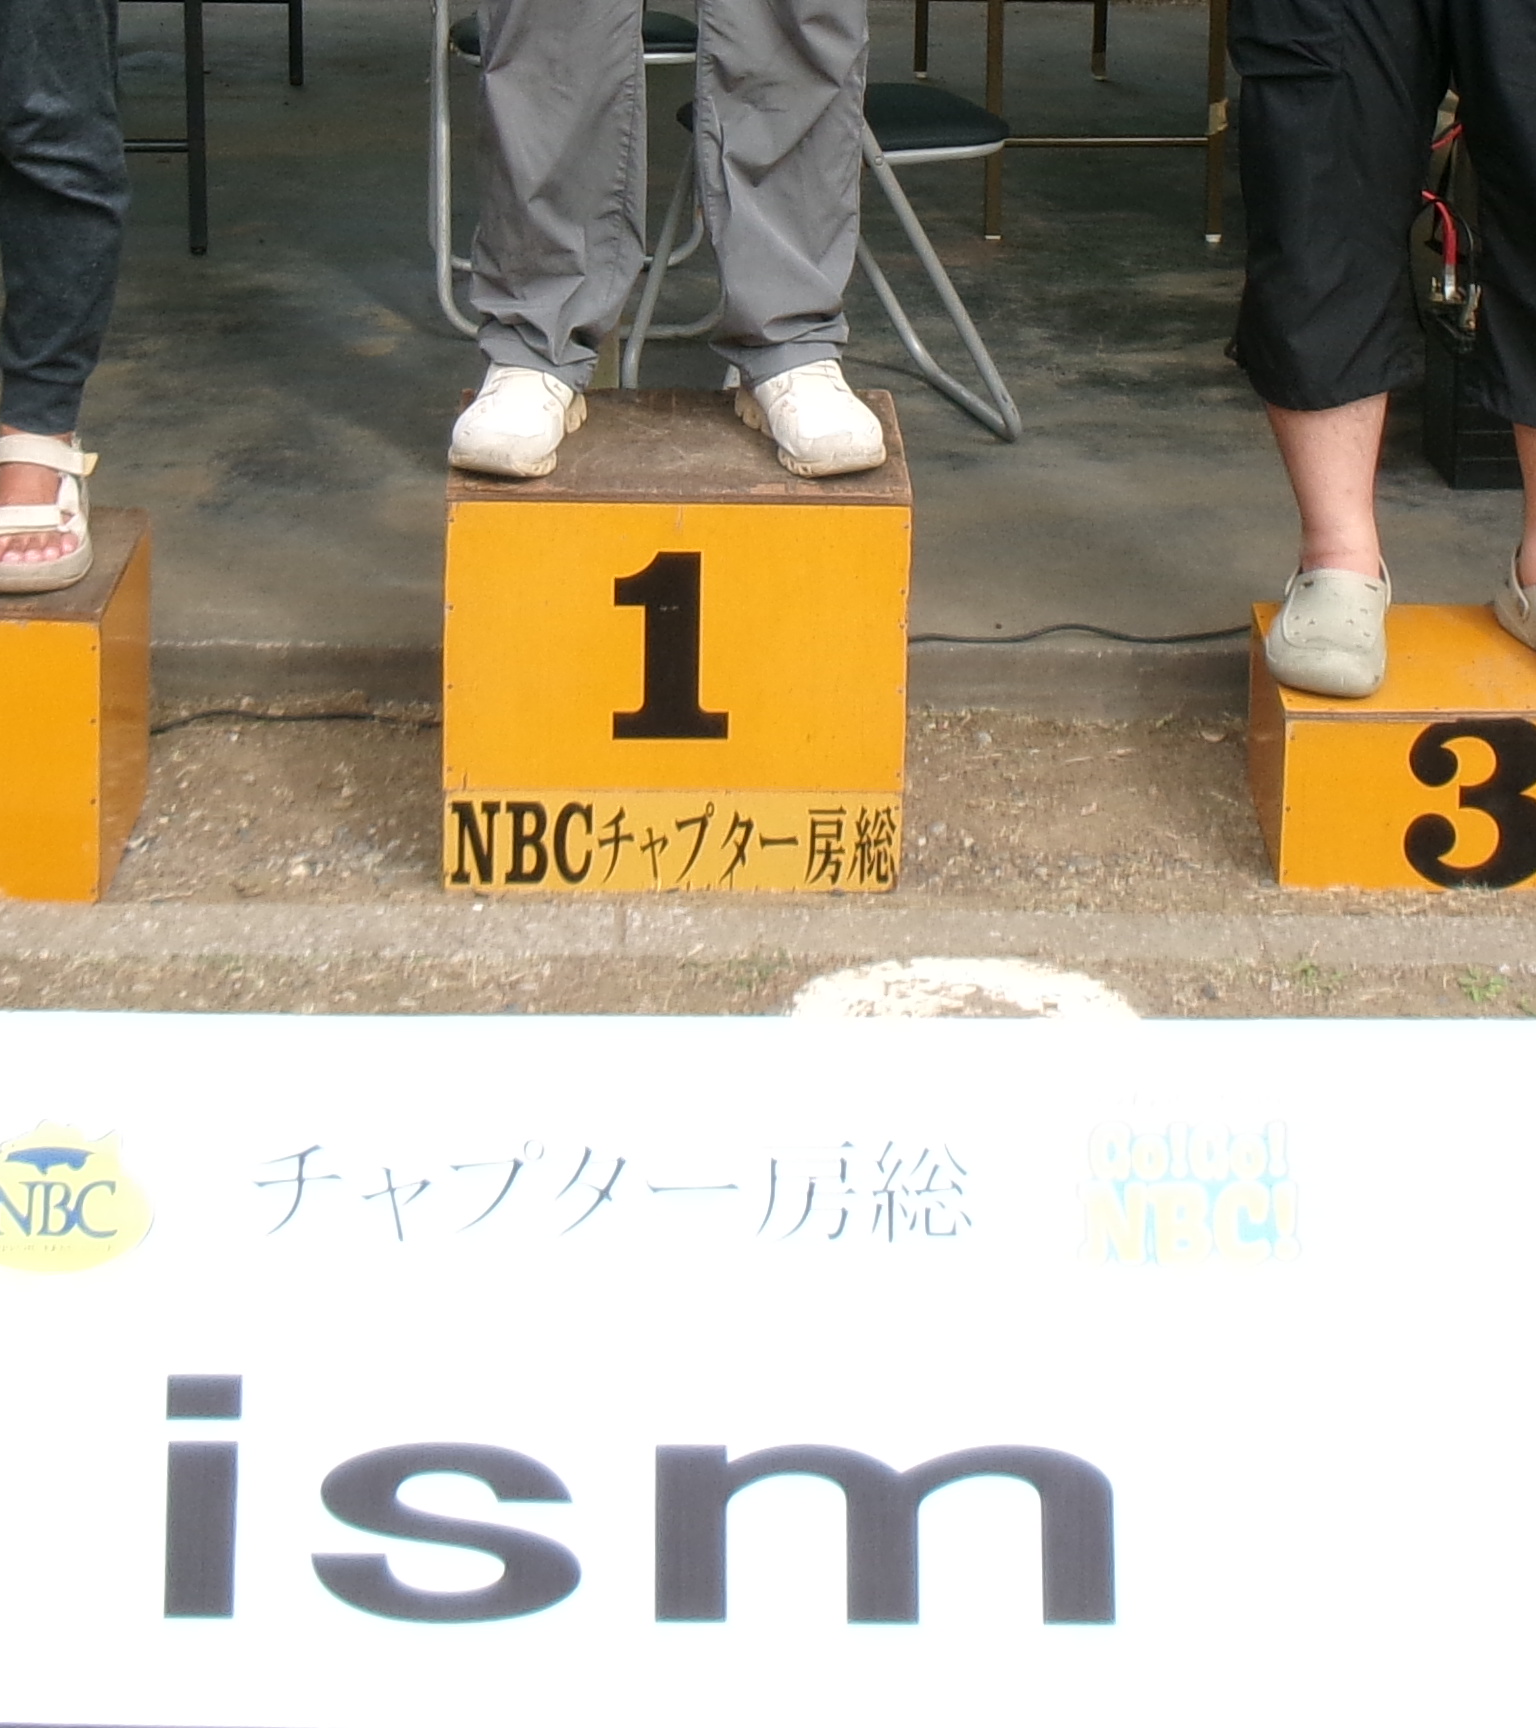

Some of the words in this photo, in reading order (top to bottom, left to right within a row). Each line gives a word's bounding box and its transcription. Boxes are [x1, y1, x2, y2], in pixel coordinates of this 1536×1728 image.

[612, 551, 729, 740] 1
[251, 1138, 973, 1245] チャプター房総
[162, 1373, 1117, 1627] ism
